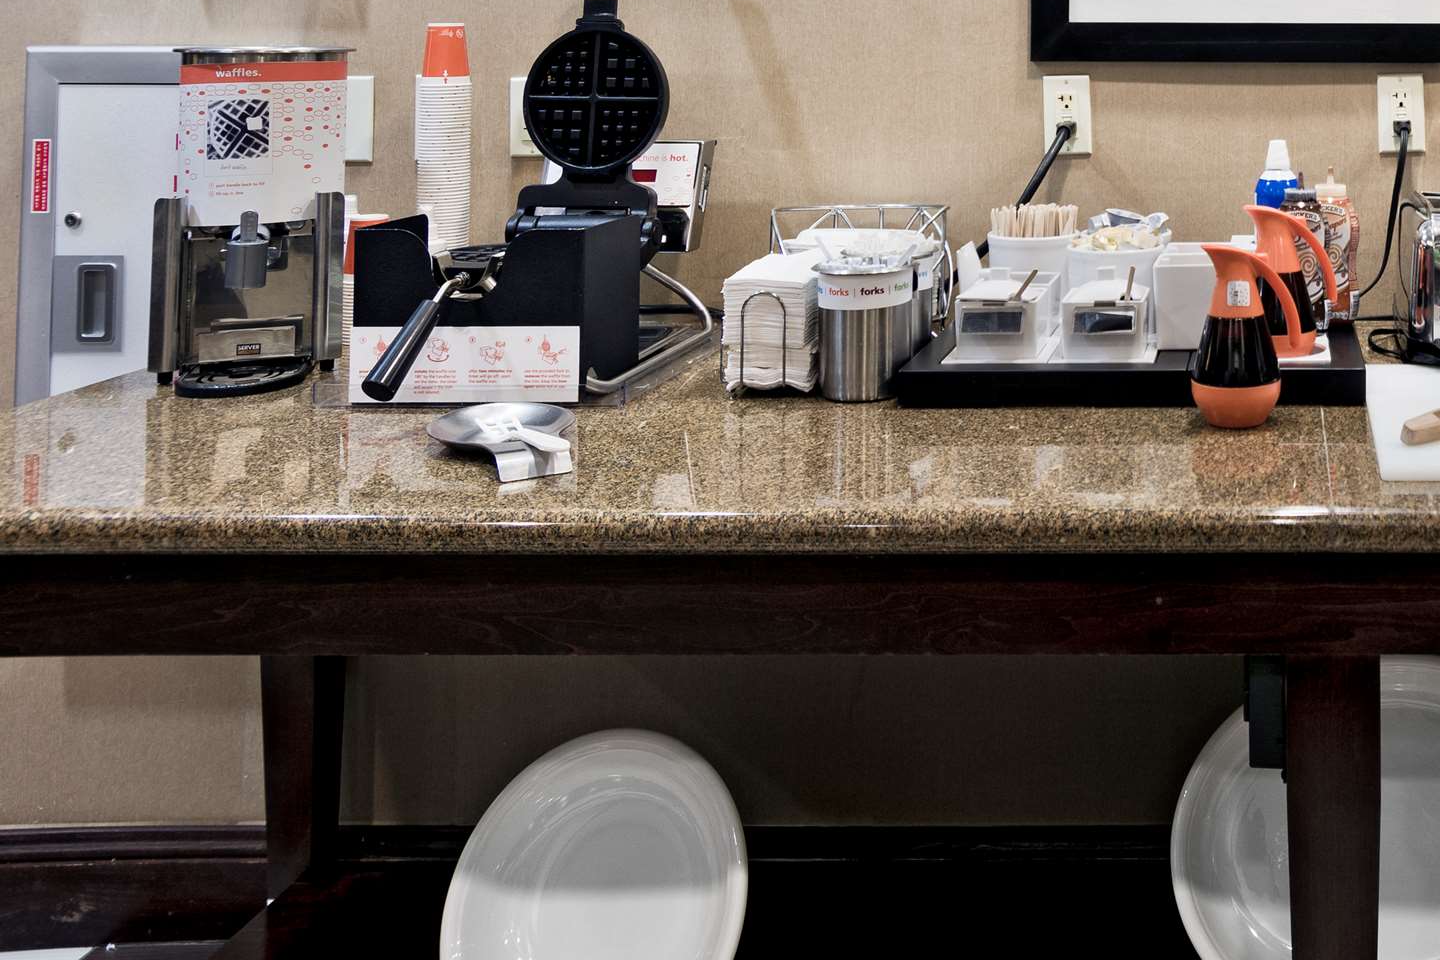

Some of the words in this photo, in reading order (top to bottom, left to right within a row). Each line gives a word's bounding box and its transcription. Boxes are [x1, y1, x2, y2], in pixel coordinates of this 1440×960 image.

[215, 67, 262, 78] waffles.
[829, 287, 849, 296] forks
[860, 286, 885, 296] forks
